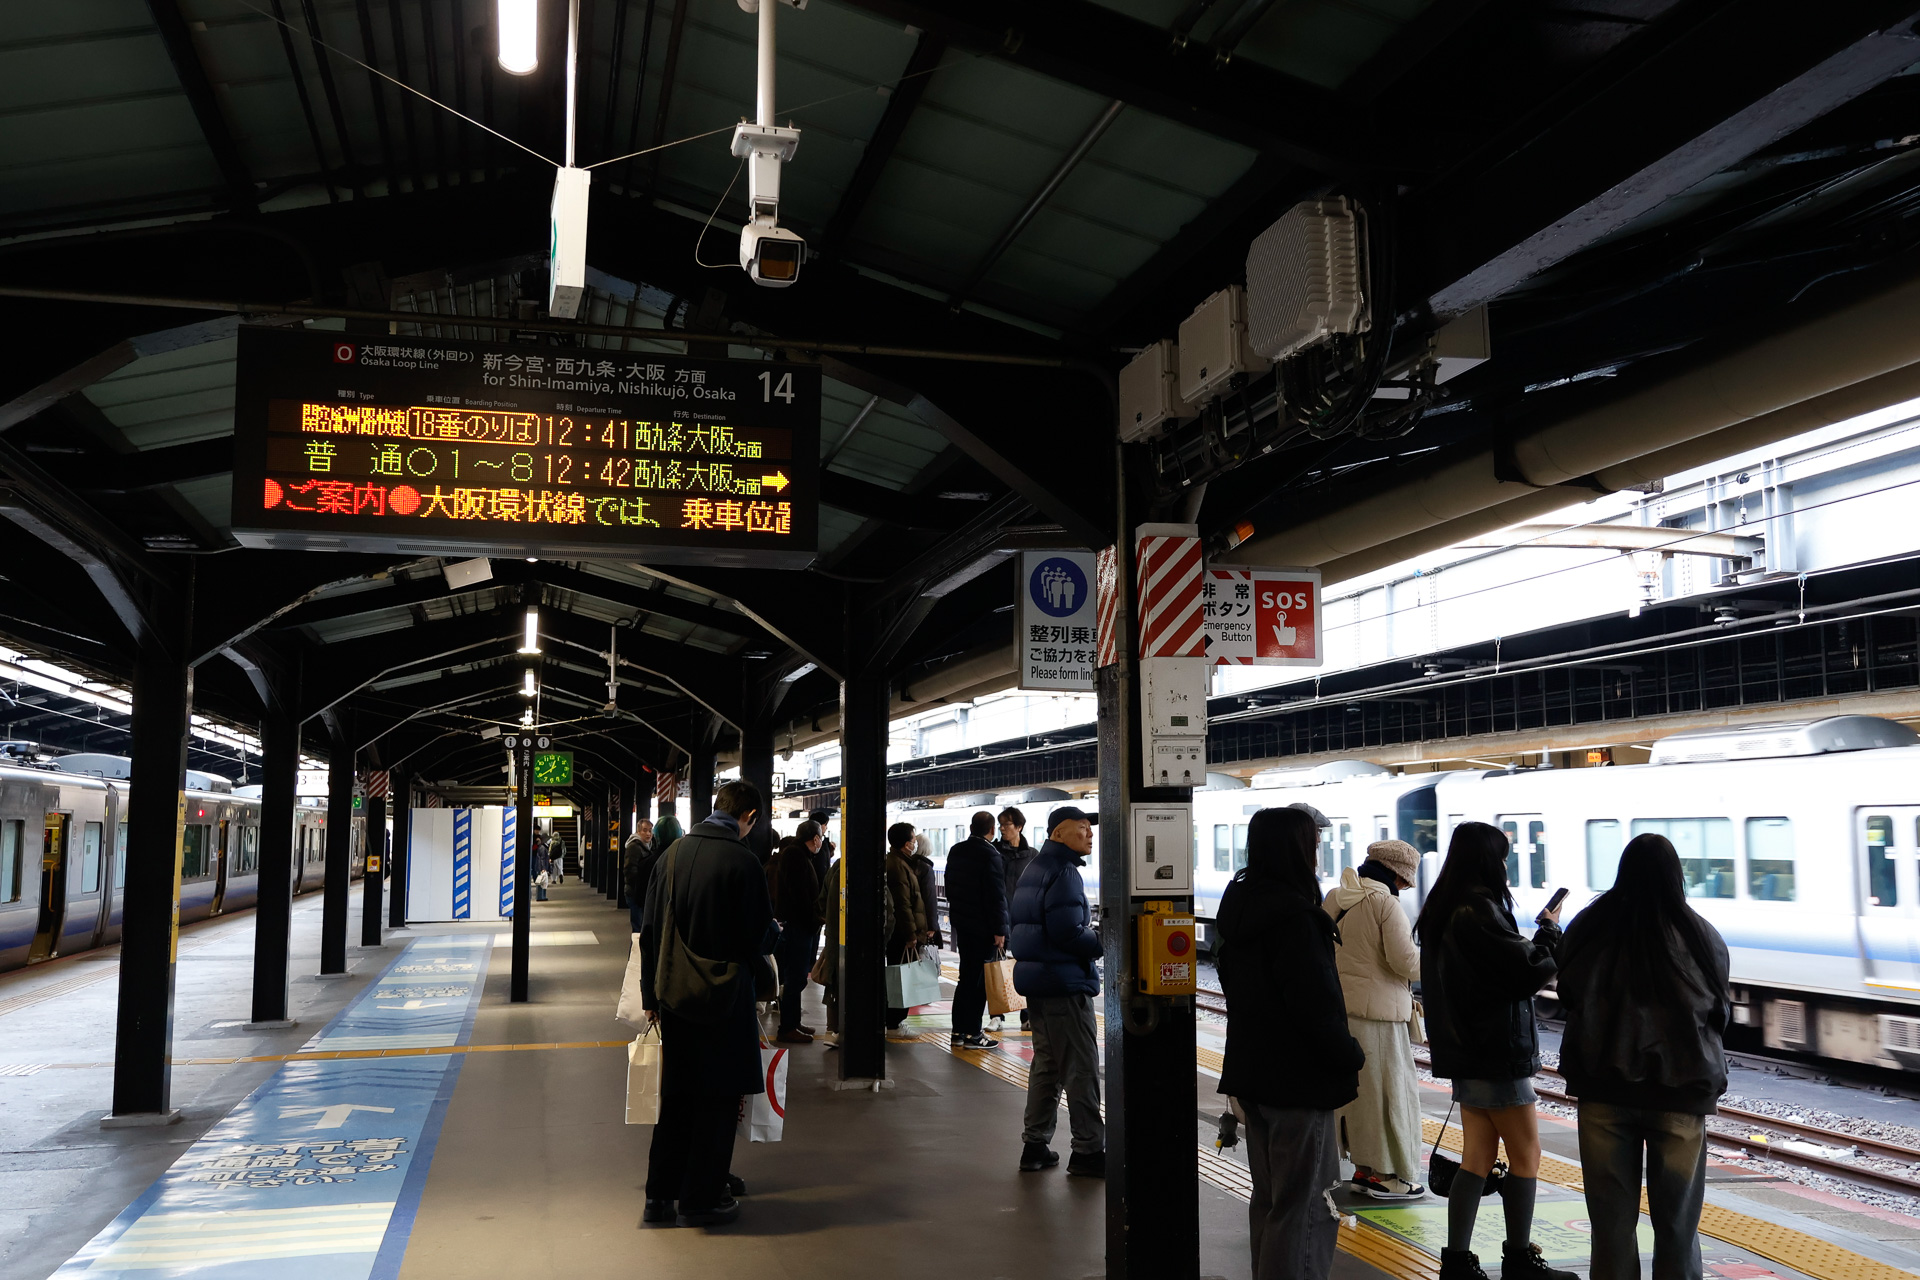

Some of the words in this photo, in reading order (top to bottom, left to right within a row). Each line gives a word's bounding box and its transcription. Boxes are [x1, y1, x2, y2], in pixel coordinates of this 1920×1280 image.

[392, 358, 417, 370] Loop
[419, 360, 440, 370] Line
[674, 368, 707, 385] 方面
[482, 372, 506, 386] for
[509, 373, 615, 395] Shin-Imamiya,
[618, 381, 689, 401] Nishikujō,
[692, 384, 736, 401] Ōsaka
[757, 370, 796, 404] 14
[359, 391, 375, 401] Type
[426, 394, 461, 405] 乗車位置
[465, 398, 493, 408] Boarding
[494, 400, 518, 409] Position
[576, 405, 606, 415] Departure
[607, 407, 623, 415] Time
[673, 410, 690, 419] 行先
[693, 412, 727, 421] Destination
[412, 410, 532, 442] 18番のりば
[1261, 591, 1307, 610] SOS
[1203, 601, 1251, 617] ボタン
[1203, 620, 1252, 631] Emergency
[1221, 631, 1252, 642] Button
[1031, 665, 1058, 680] Please
[1059, 666, 1079, 681] form
